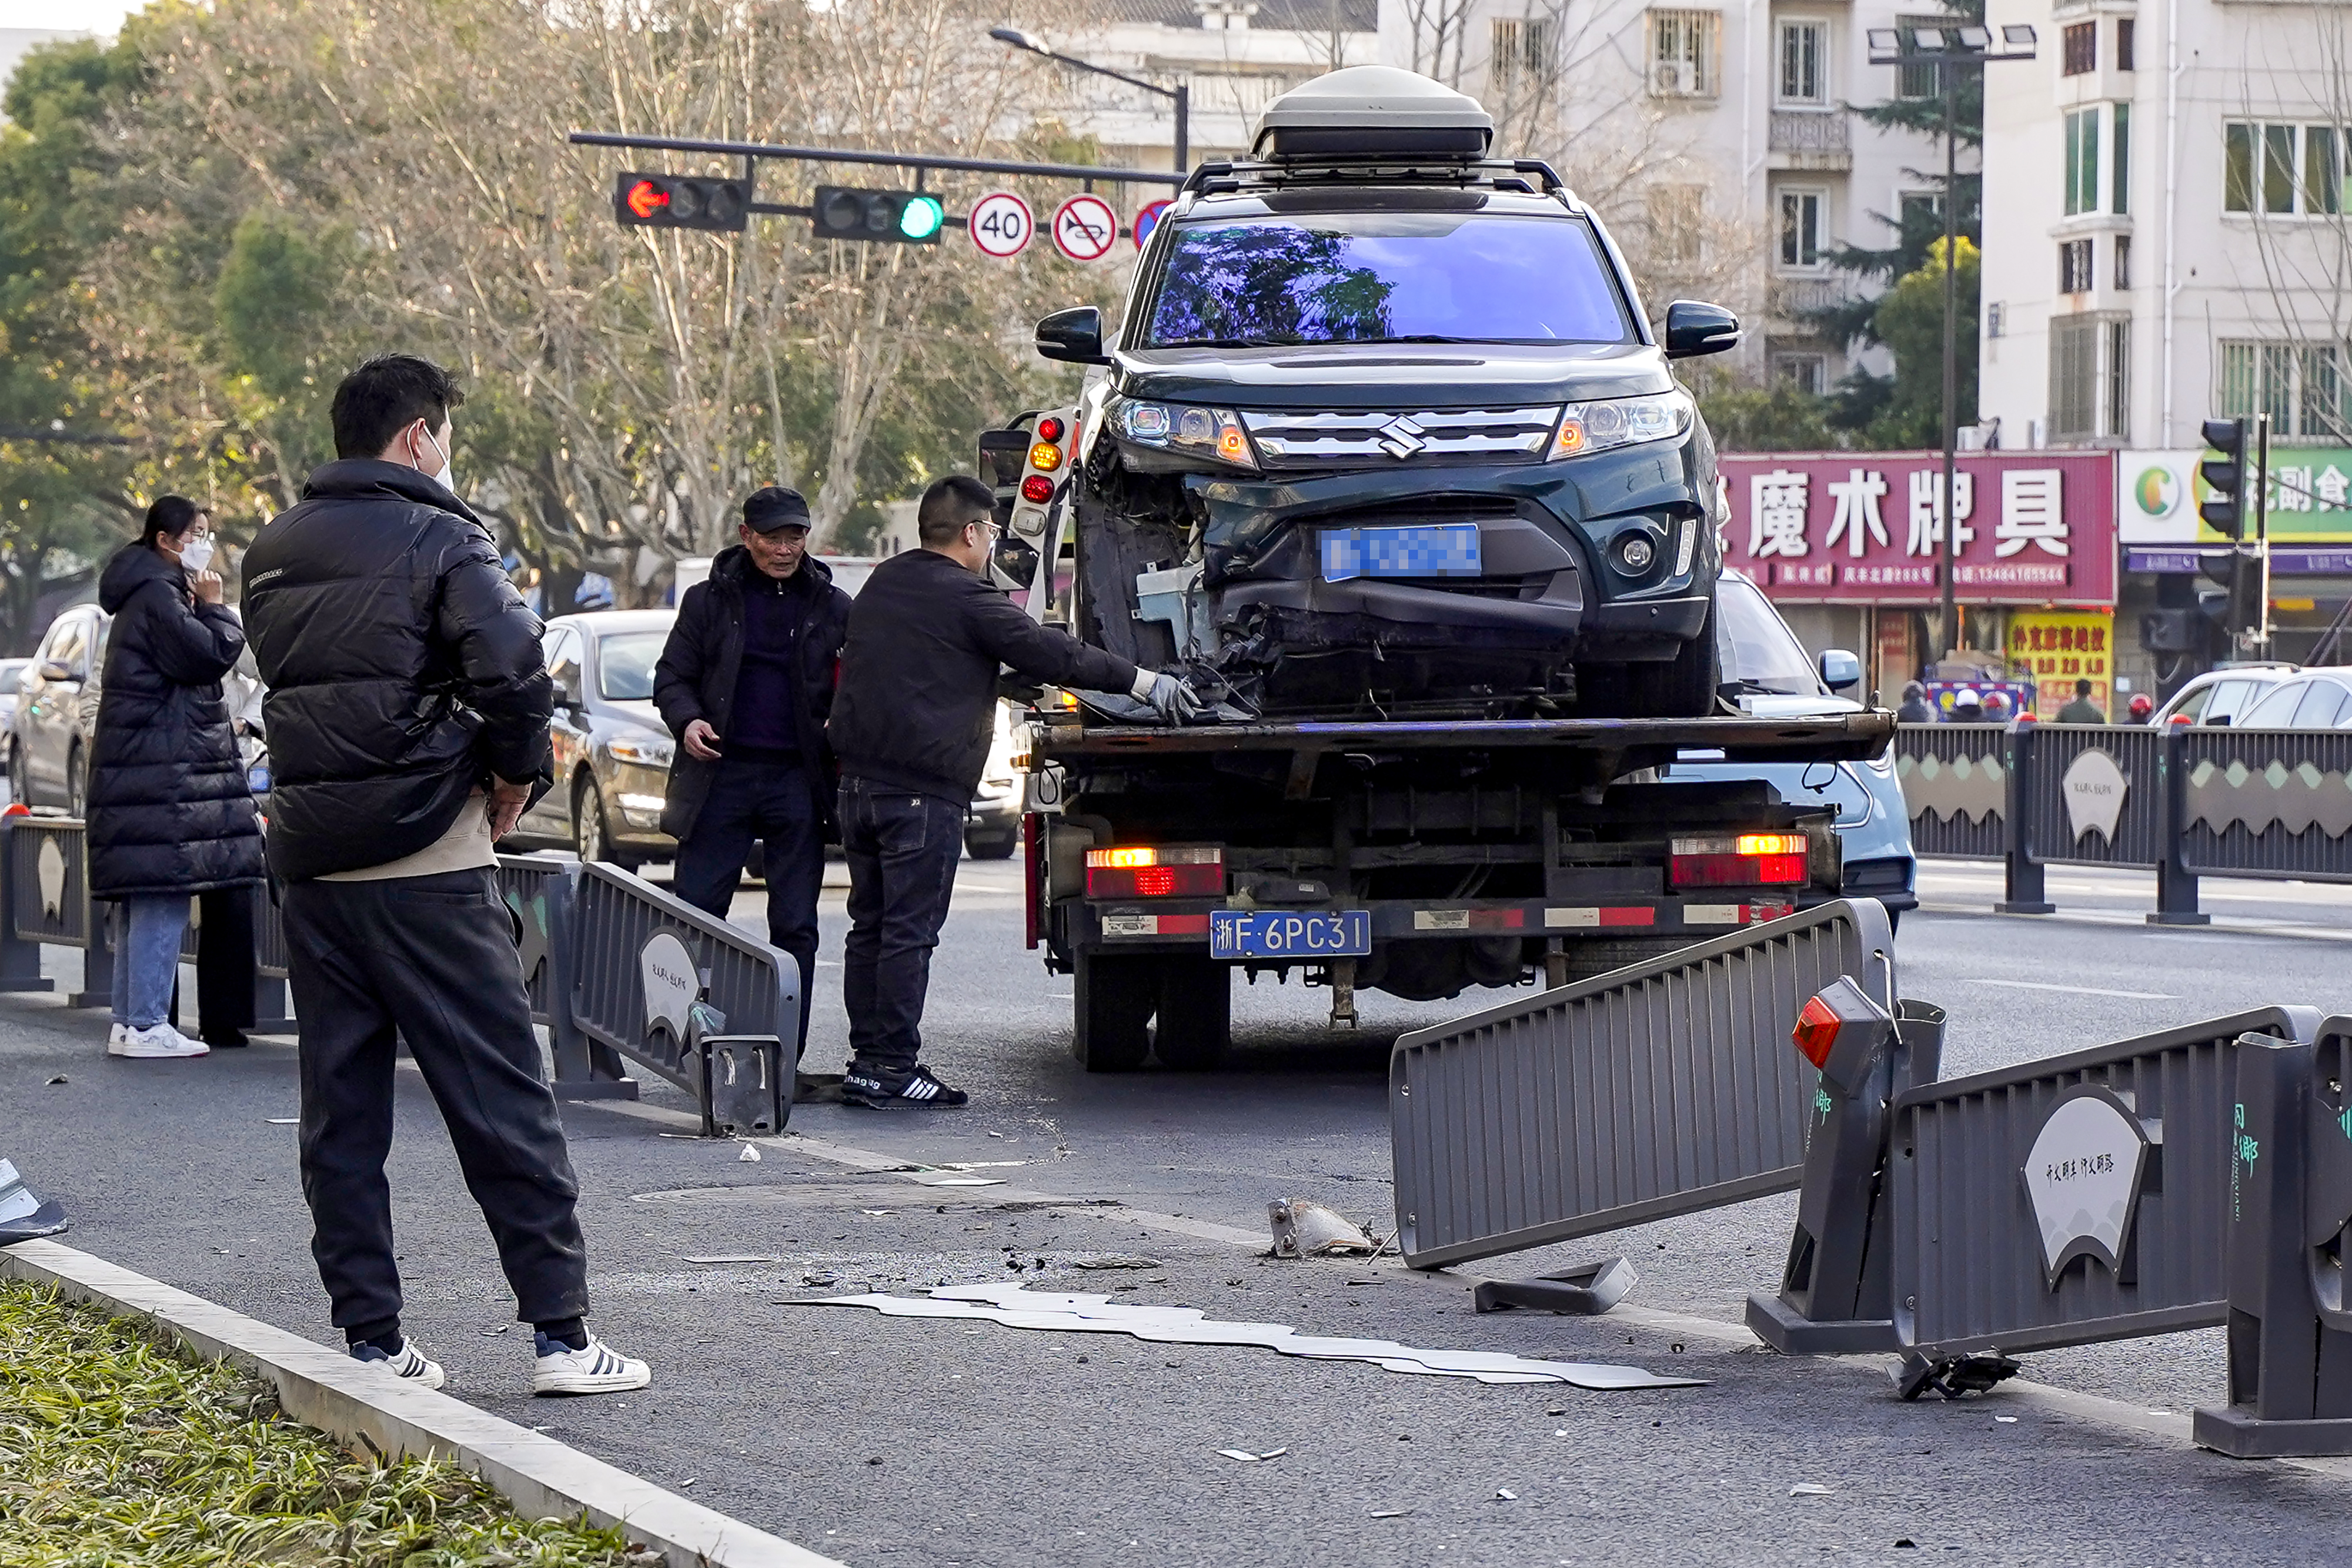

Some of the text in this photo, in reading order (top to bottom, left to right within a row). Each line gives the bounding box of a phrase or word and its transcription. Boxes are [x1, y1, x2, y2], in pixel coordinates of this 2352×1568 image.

[980, 209, 1020, 239] 40
[1716, 469, 2069, 558] 魔术牌具
